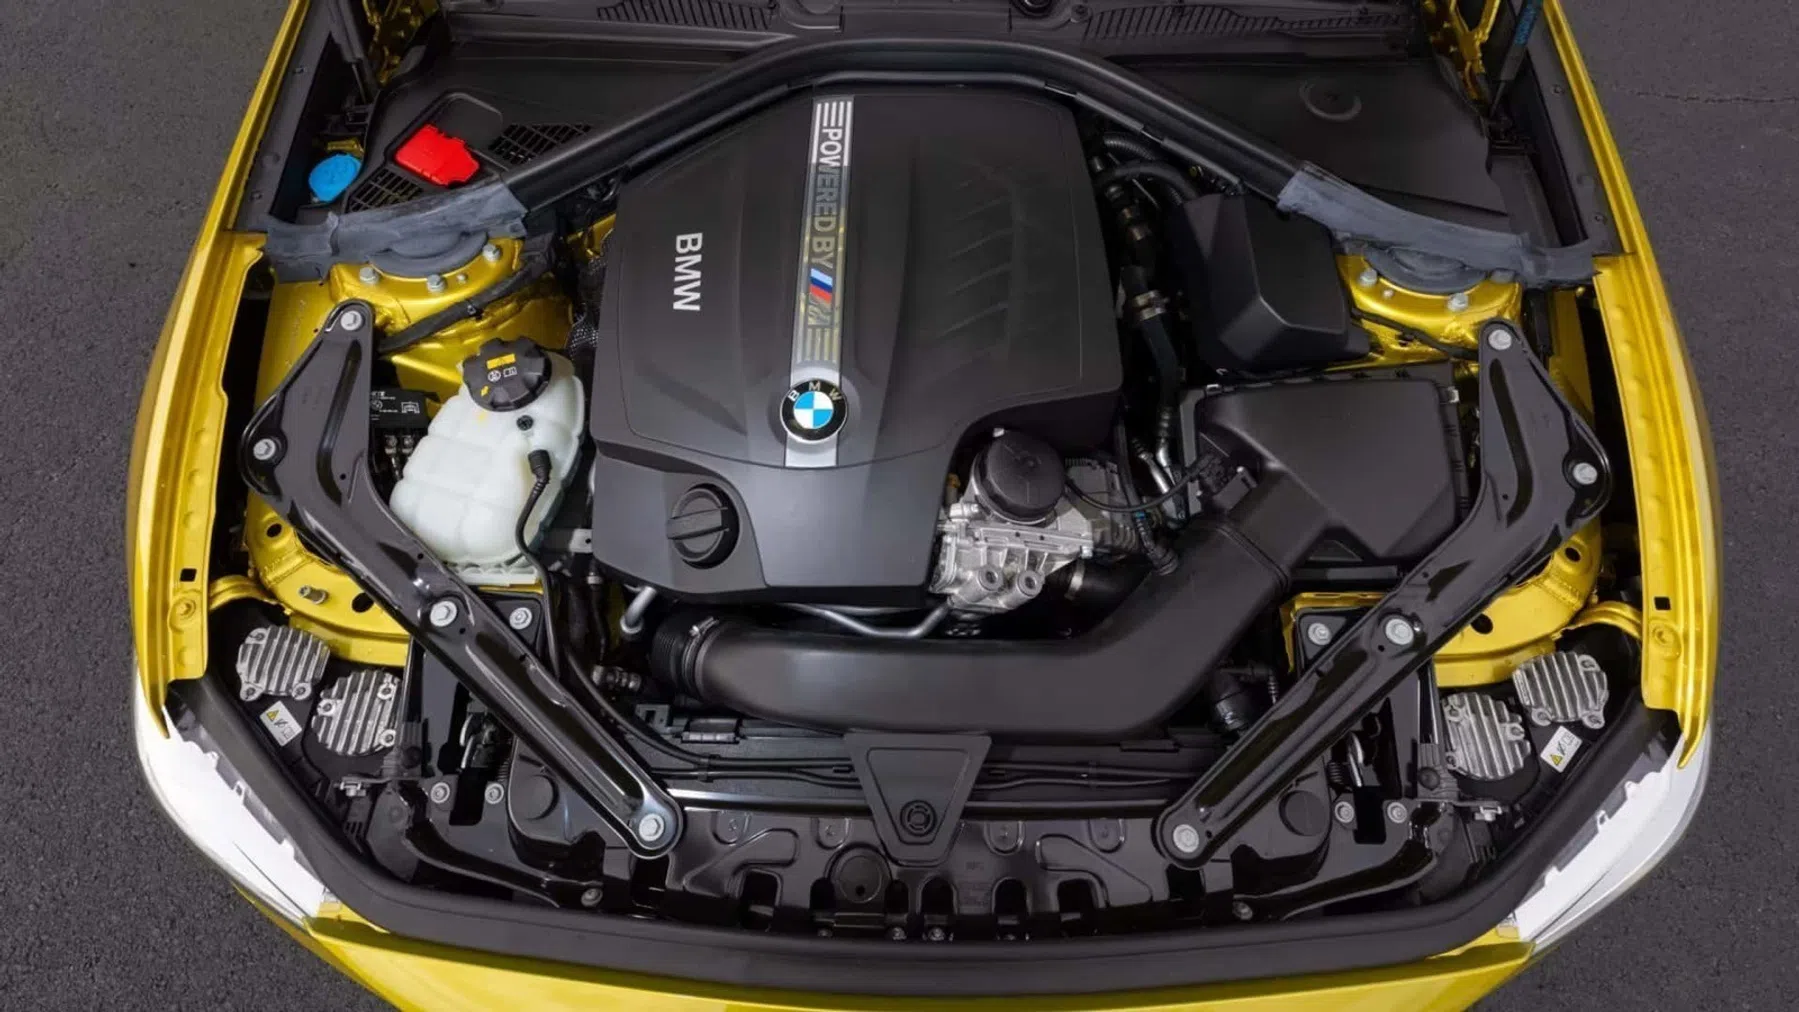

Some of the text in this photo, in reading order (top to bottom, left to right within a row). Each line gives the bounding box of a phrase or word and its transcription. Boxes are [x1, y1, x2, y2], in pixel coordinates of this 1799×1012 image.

[813, 128, 843, 232] POWERED
[673, 232, 703, 311] BMW
[811, 236, 836, 269] BY
[787, 380, 843, 402] BMW
